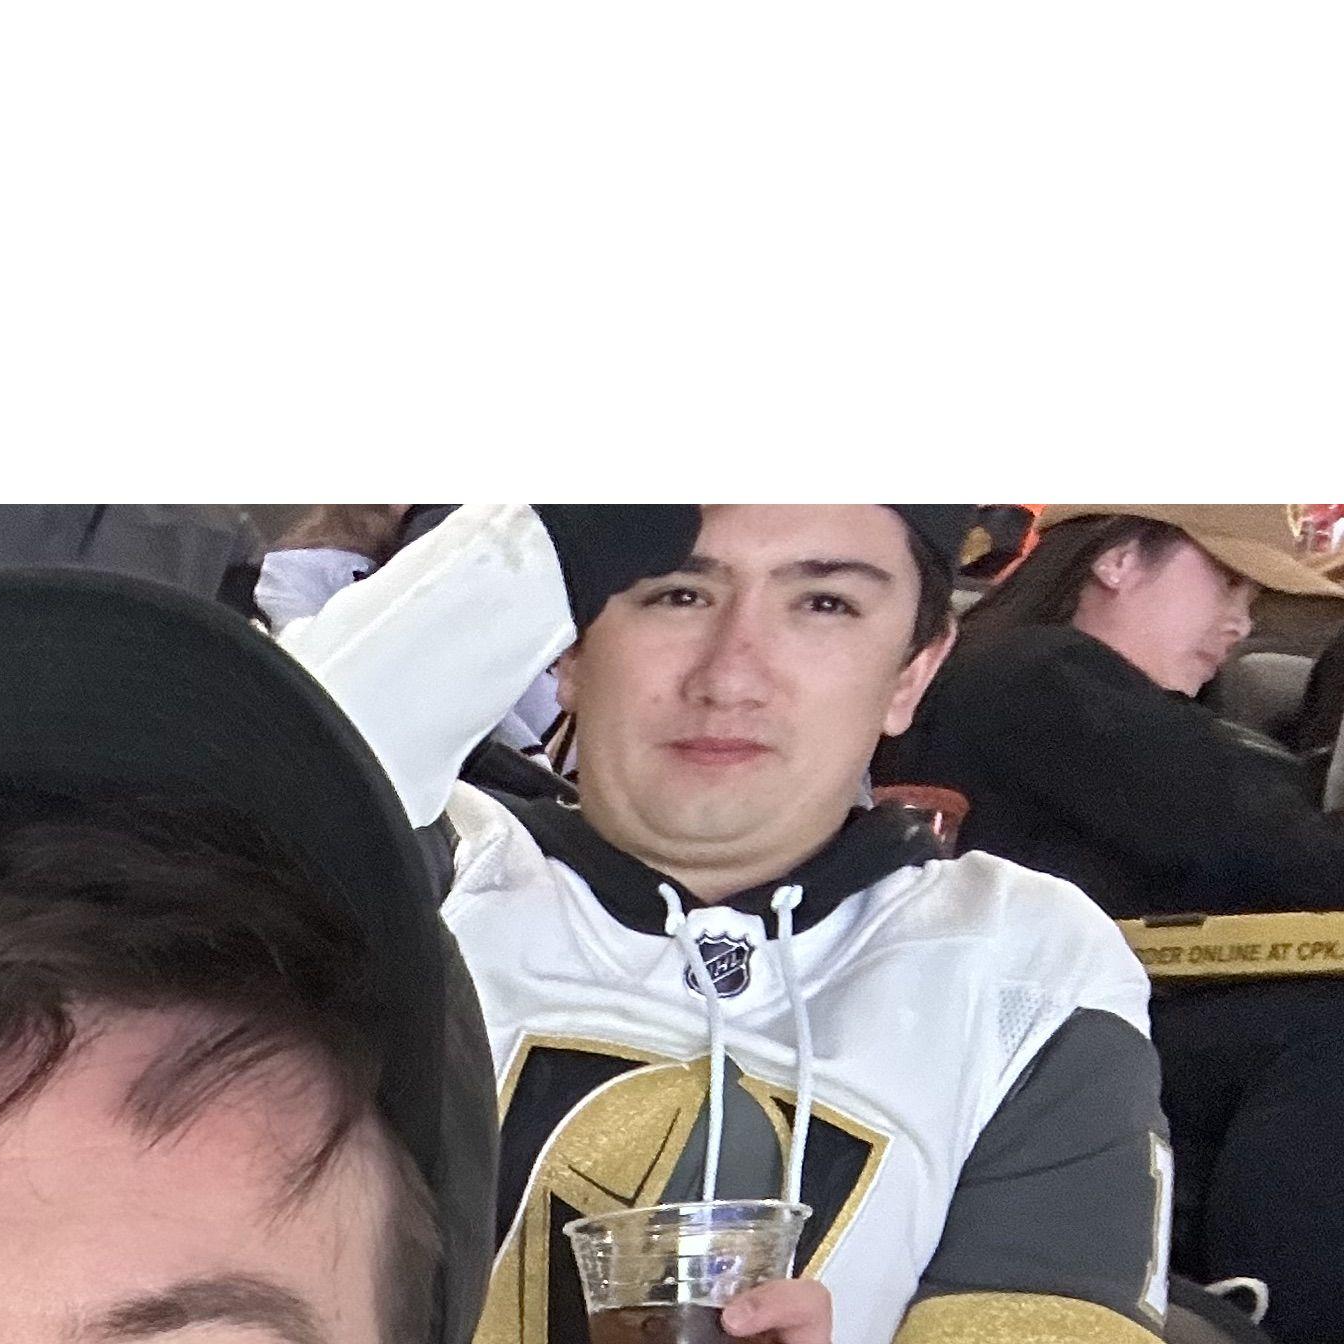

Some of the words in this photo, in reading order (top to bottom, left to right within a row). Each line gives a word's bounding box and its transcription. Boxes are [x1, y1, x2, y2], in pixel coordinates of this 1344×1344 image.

[708, 951, 743, 977] HL
[1189, 945, 1261, 963] ONLINE
[1267, 943, 1292, 960] AT
